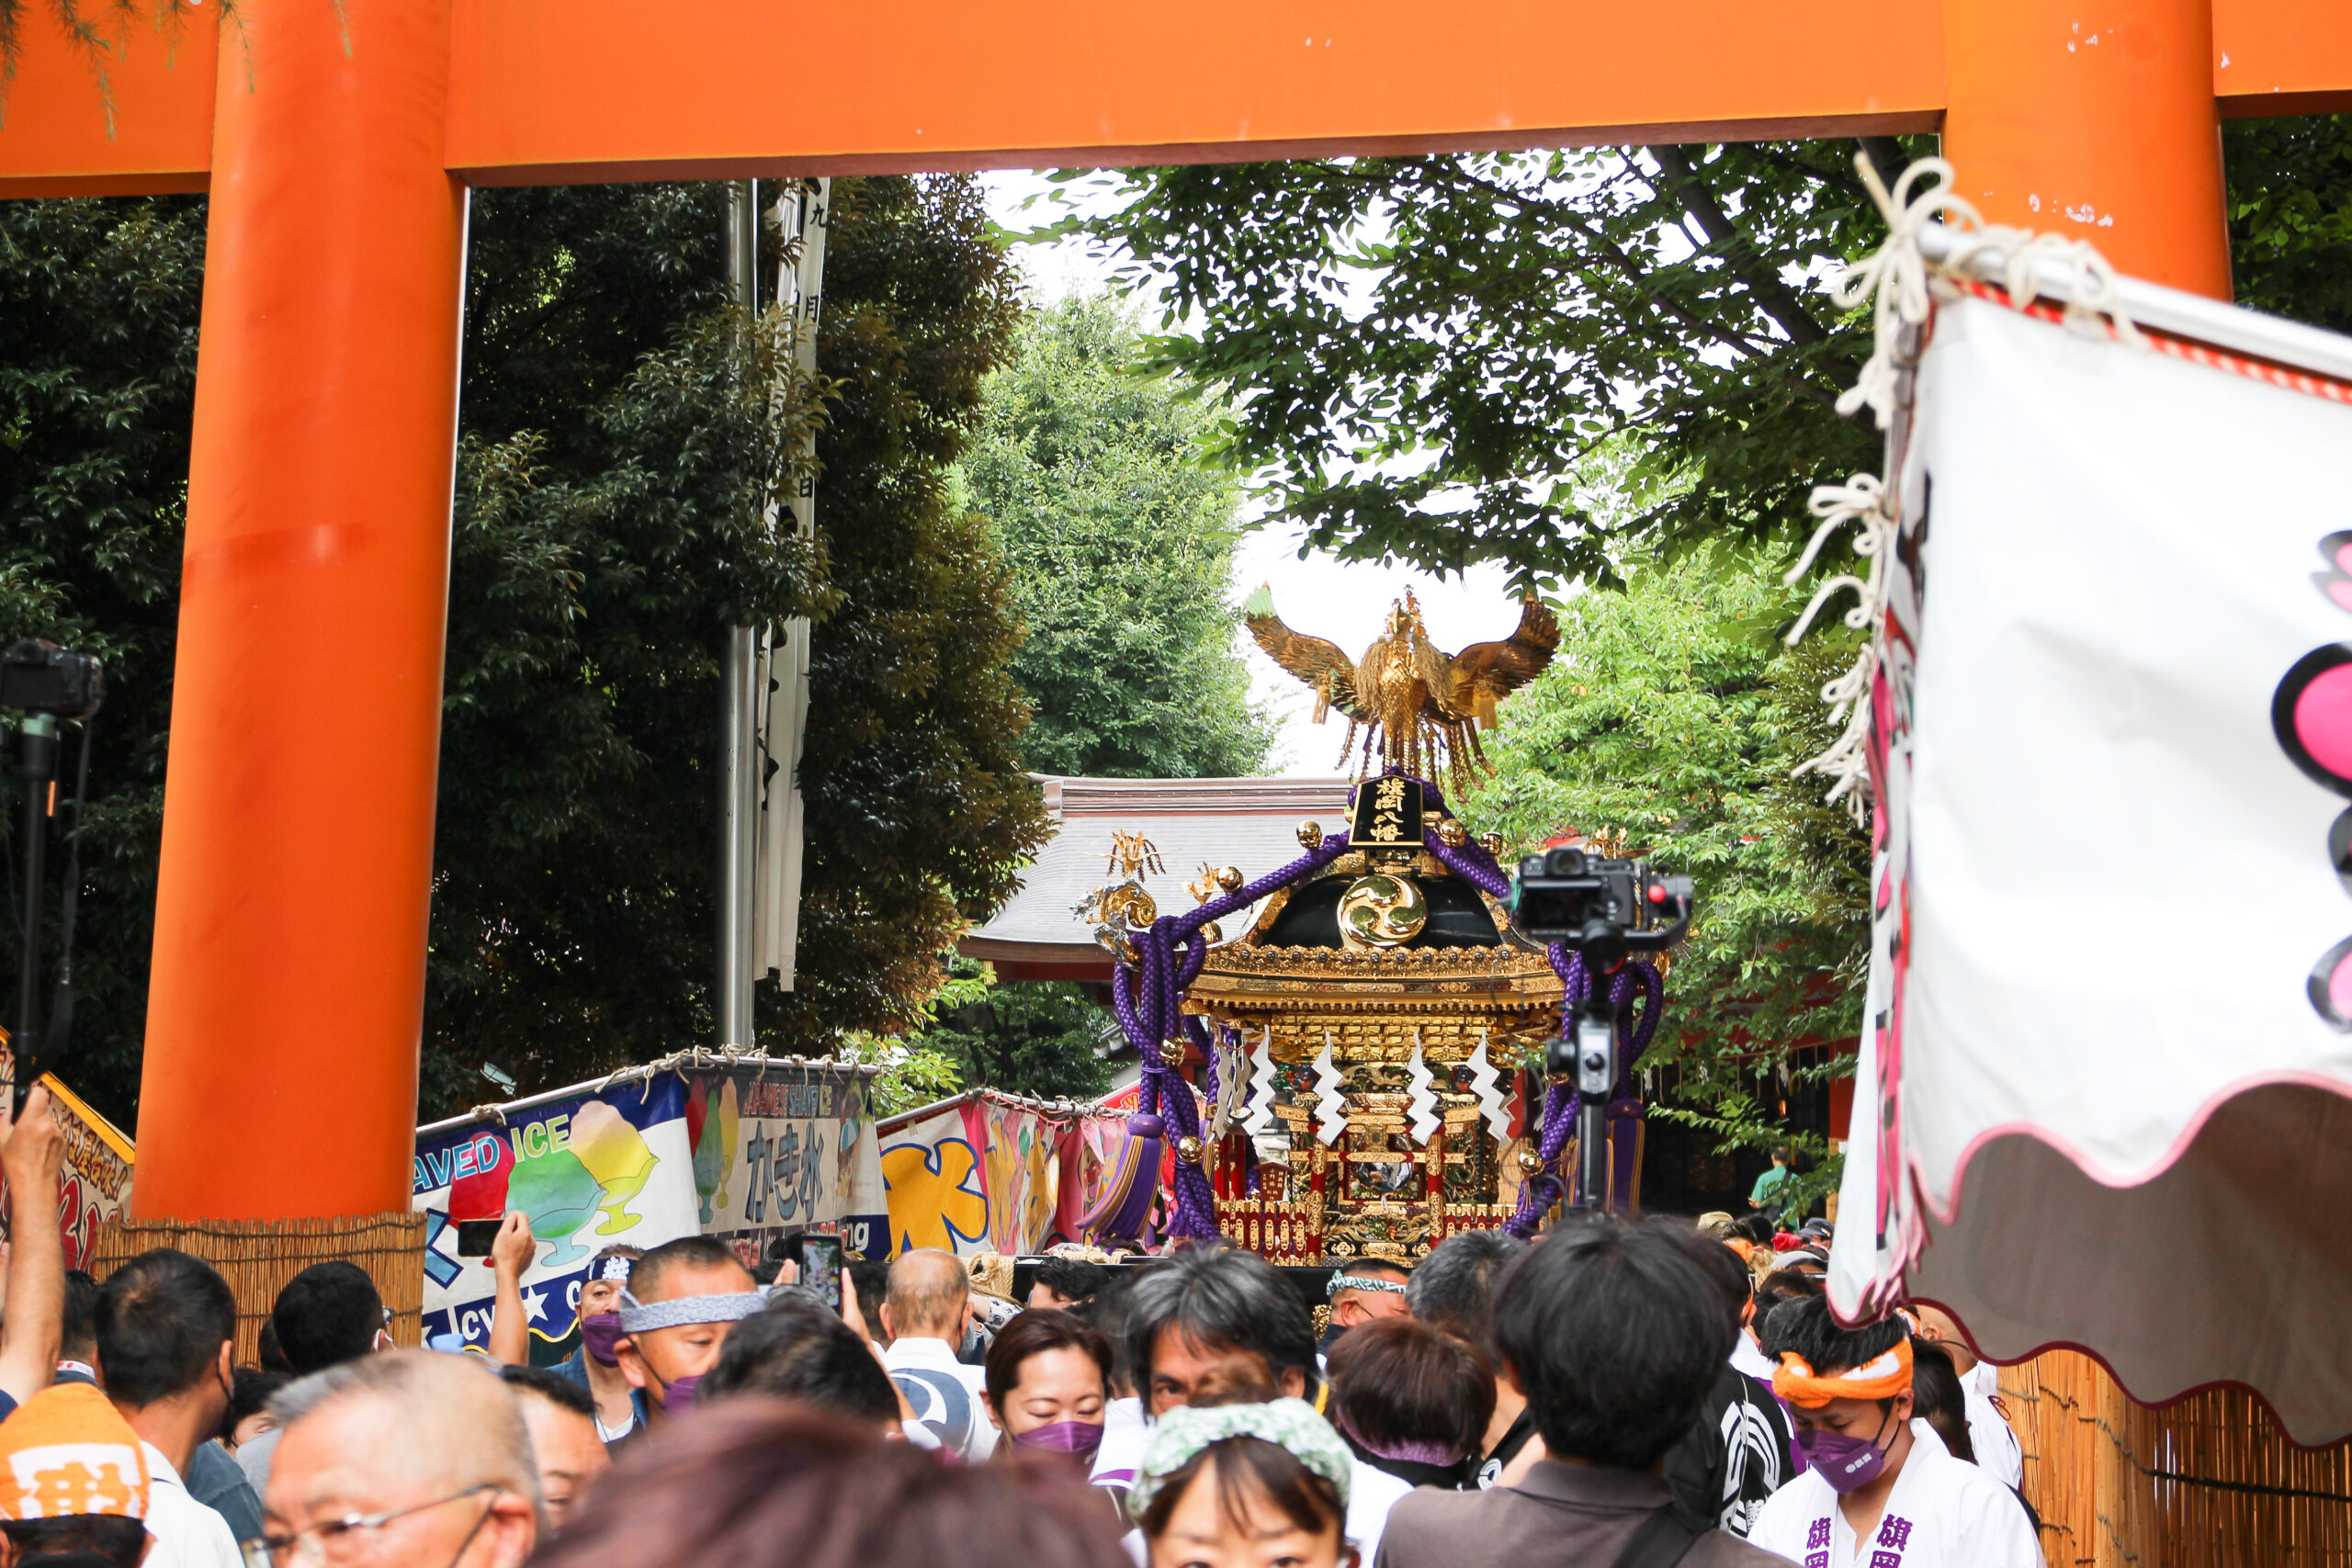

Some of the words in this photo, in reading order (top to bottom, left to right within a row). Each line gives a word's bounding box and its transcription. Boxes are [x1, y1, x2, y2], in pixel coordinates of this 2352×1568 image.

[1370, 778, 1406, 841] 旗岡八幡
[510, 1113, 575, 1163] ICE
